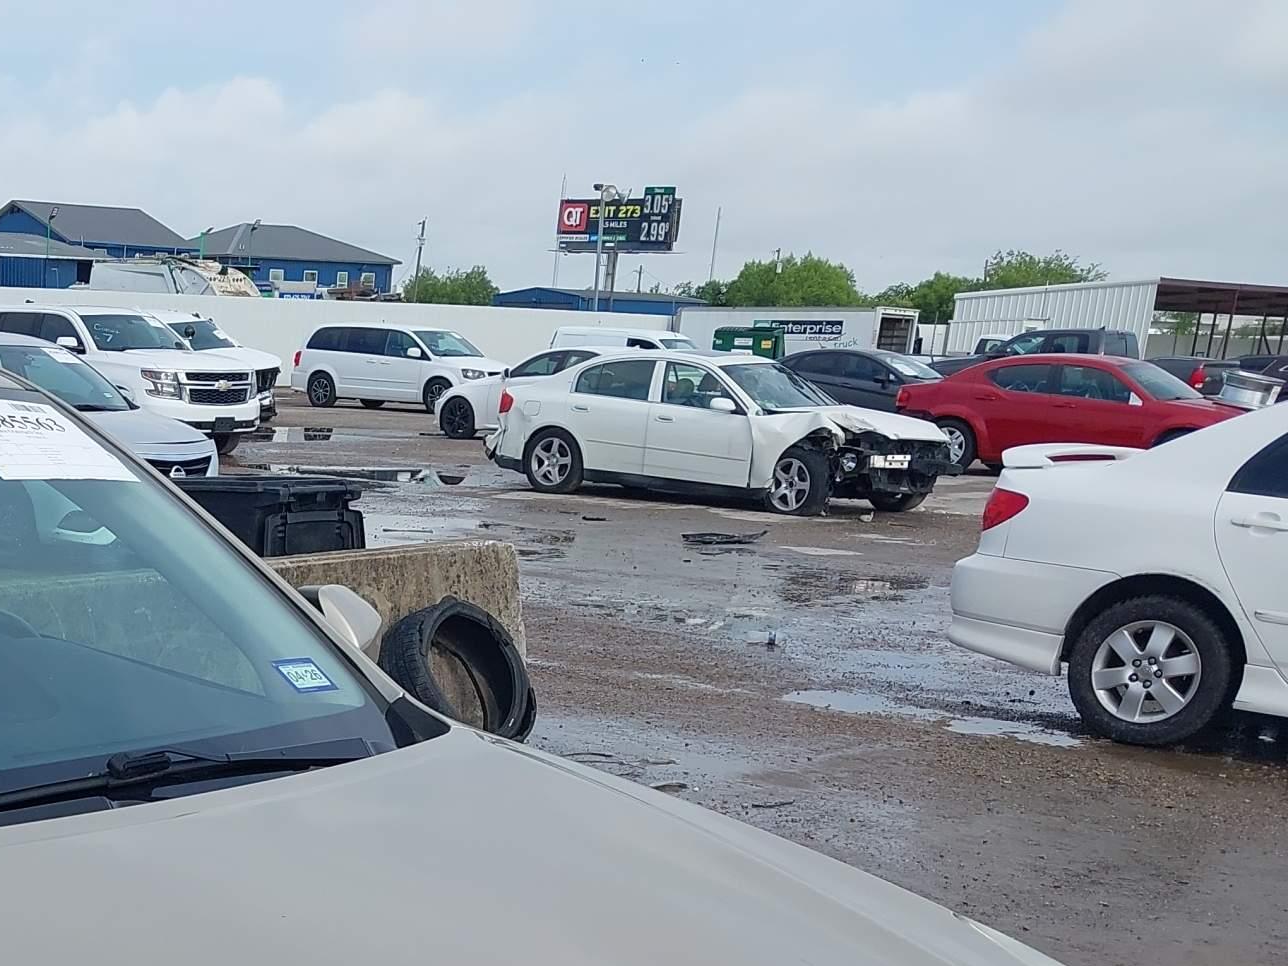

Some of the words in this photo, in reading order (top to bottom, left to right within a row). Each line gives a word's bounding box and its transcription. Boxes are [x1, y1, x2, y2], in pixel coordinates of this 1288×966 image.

[563, 207, 584, 227] QT
[618, 205, 641, 218] 273
[771, 321, 842, 335] Enterprise
[286, 671, 306, 683] 04
[304, 669, 323, 681] 26
